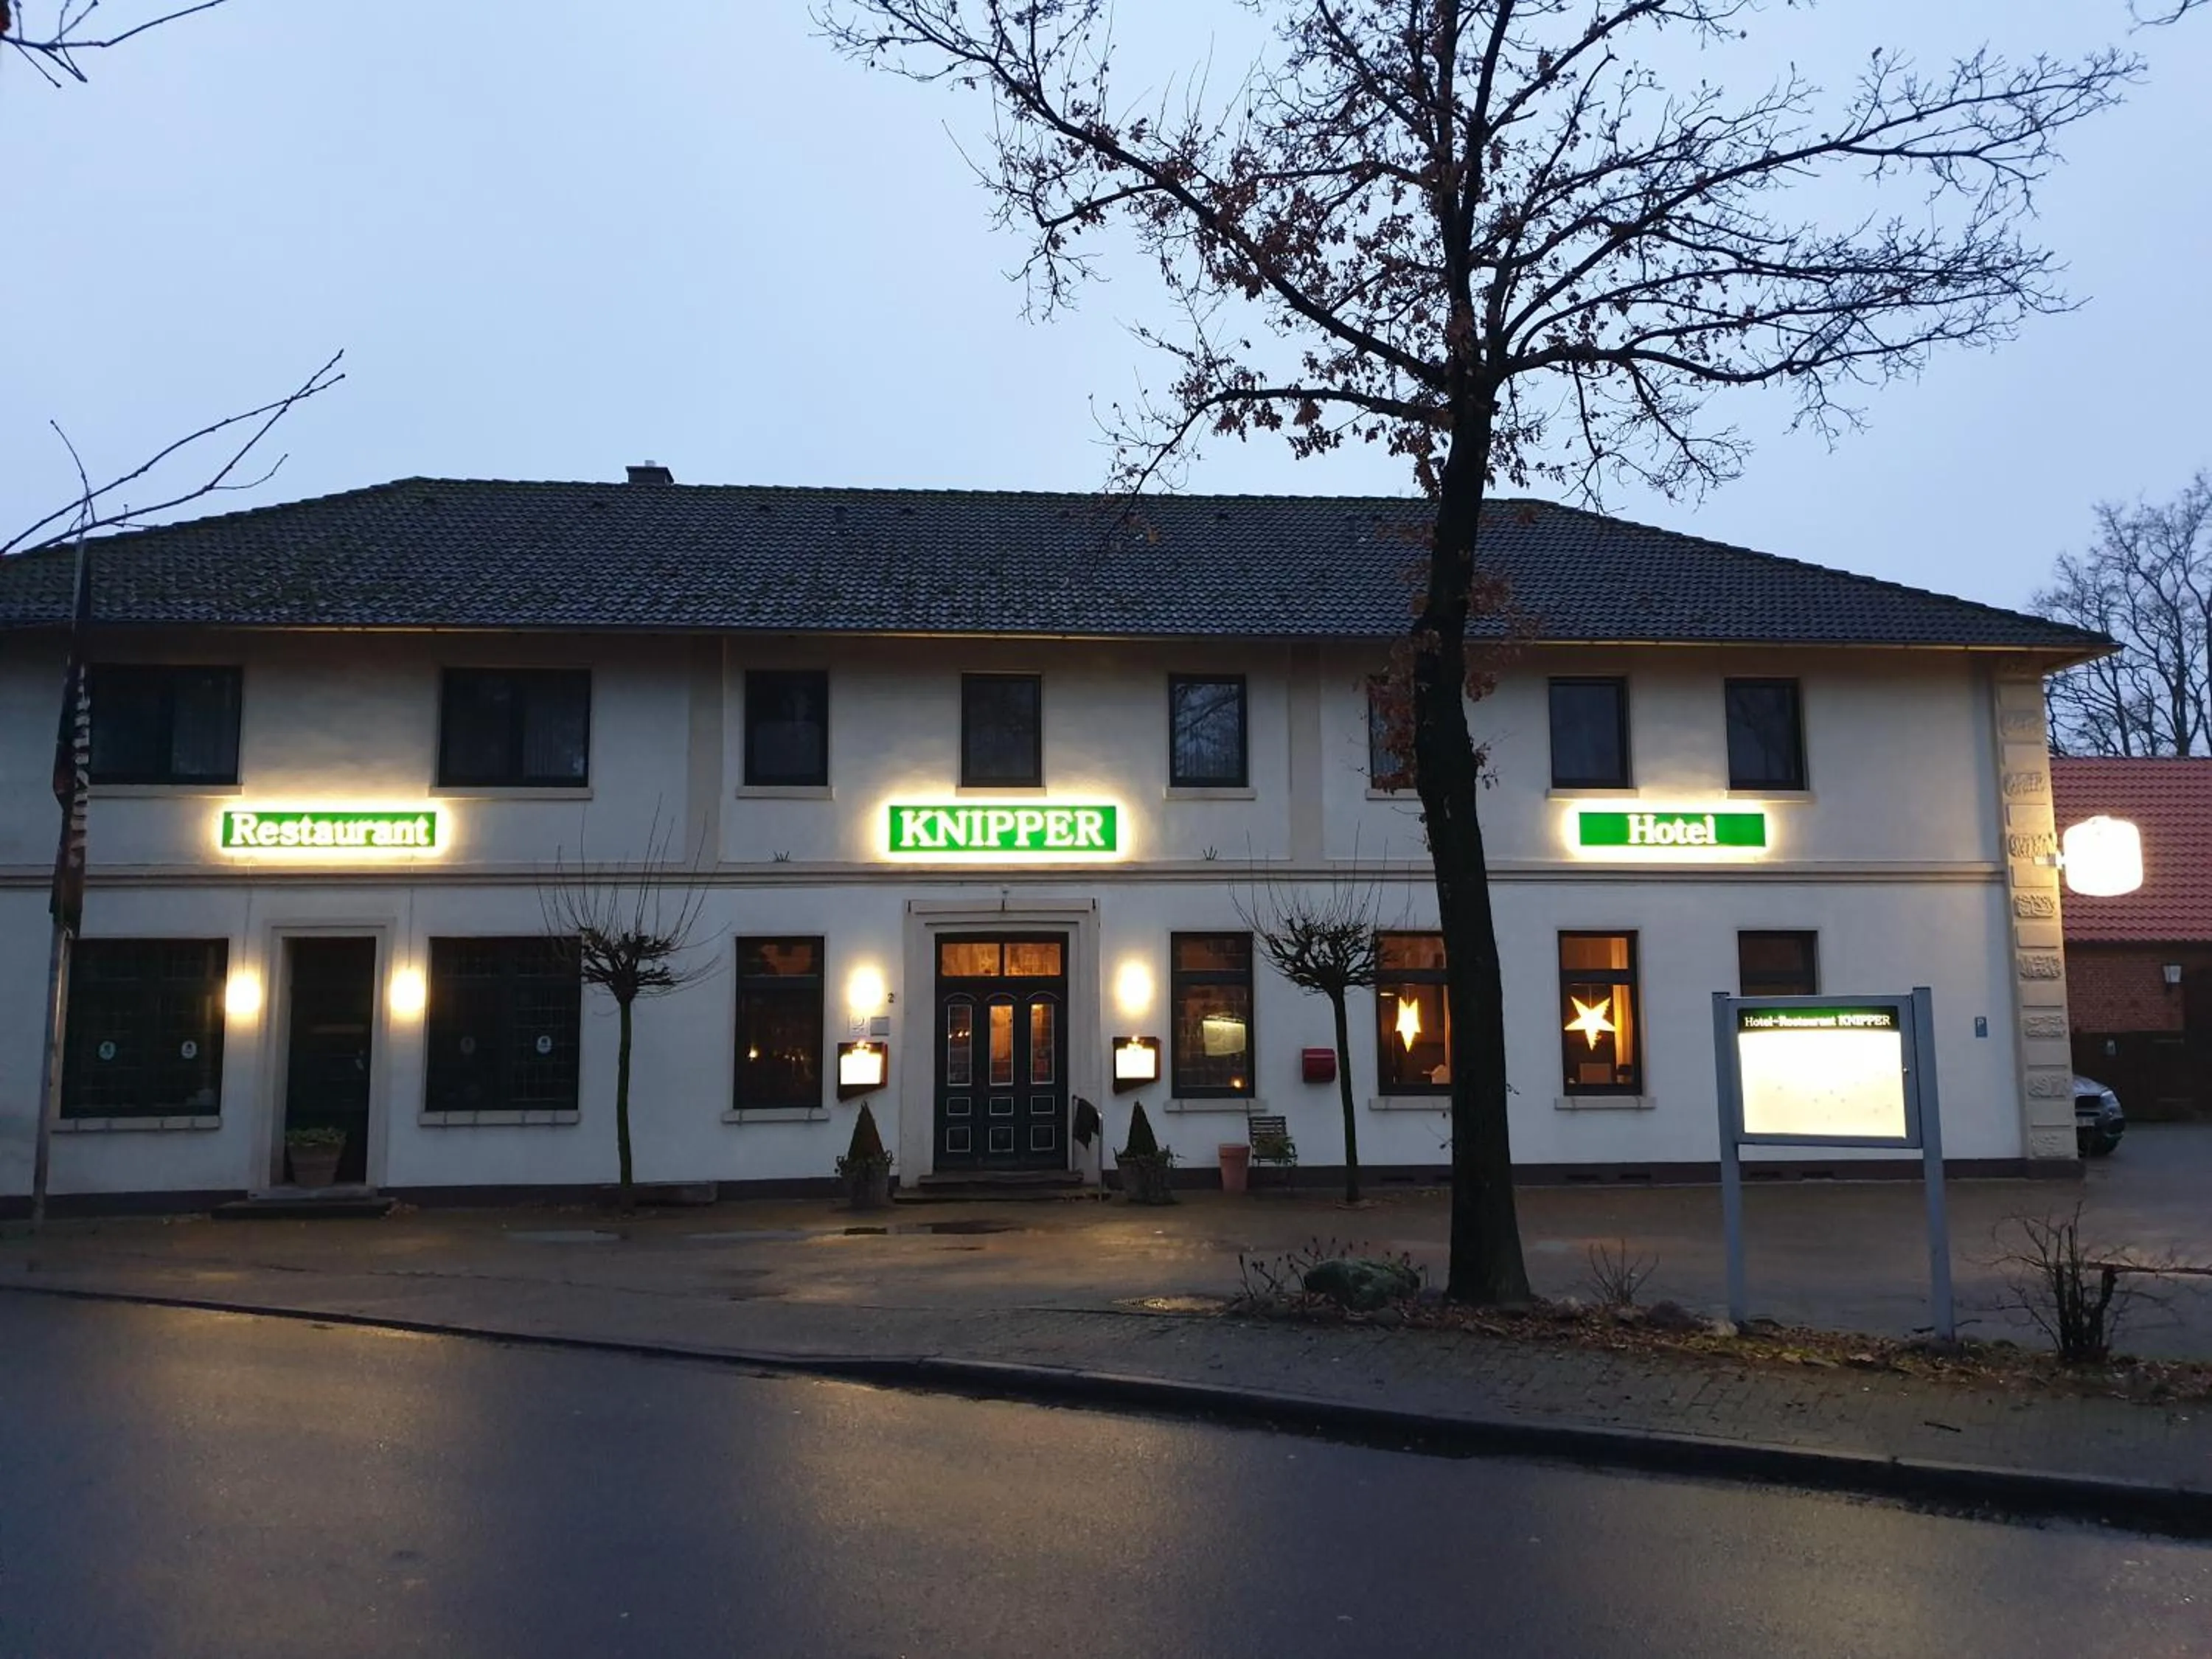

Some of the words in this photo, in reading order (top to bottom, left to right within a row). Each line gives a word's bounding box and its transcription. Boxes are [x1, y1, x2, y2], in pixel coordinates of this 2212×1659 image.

[229, 813, 429, 846] Restaurant
[899, 810, 1105, 847] KNIPPER
[1627, 813, 1718, 845] Hotel
[1838, 1014, 1891, 1026] KNIPPER
